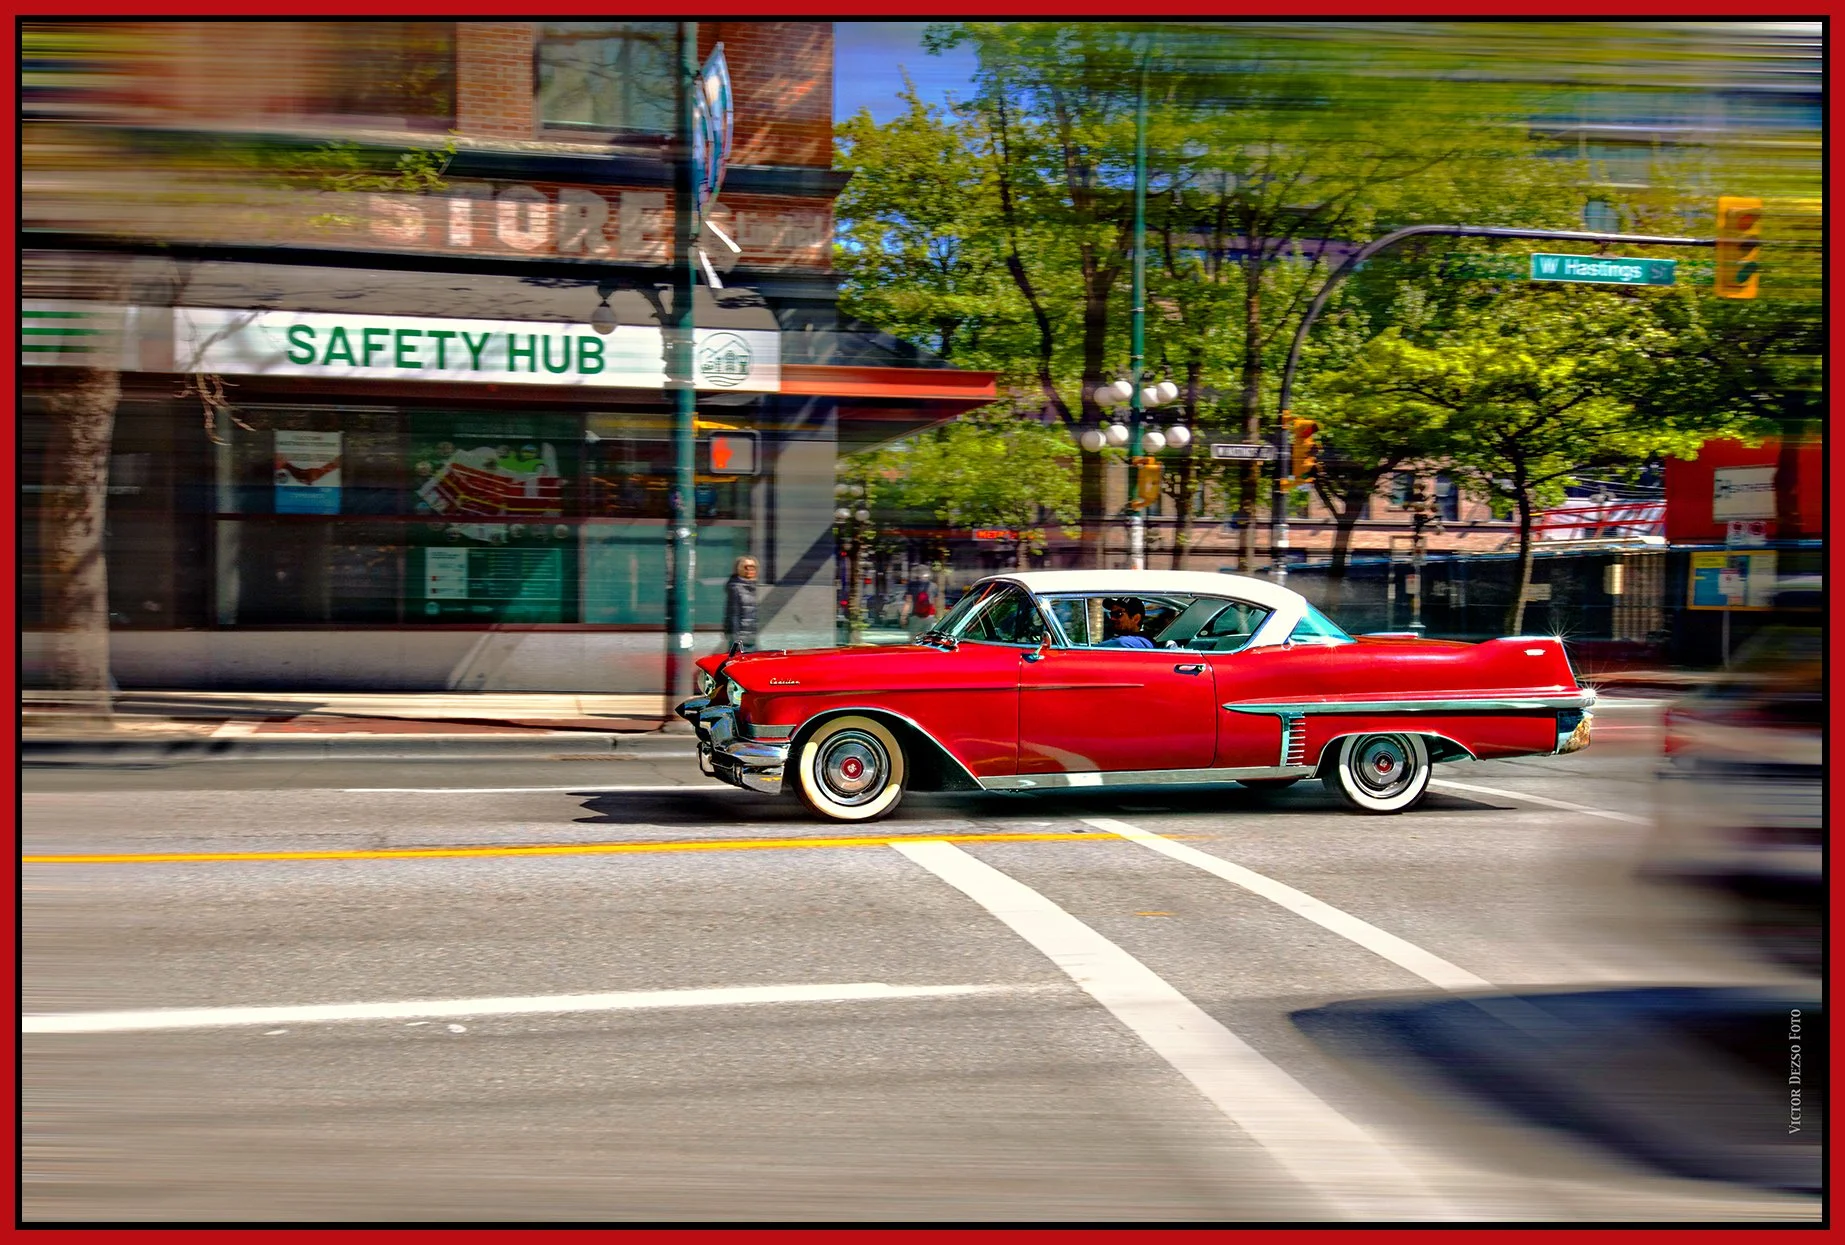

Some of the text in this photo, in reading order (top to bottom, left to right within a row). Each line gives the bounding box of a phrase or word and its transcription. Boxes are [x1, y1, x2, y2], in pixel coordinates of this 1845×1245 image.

[1539, 257, 1559, 275] W
[1564, 258, 1643, 282] Hastings
[287, 324, 606, 375] SAFETY HUB
